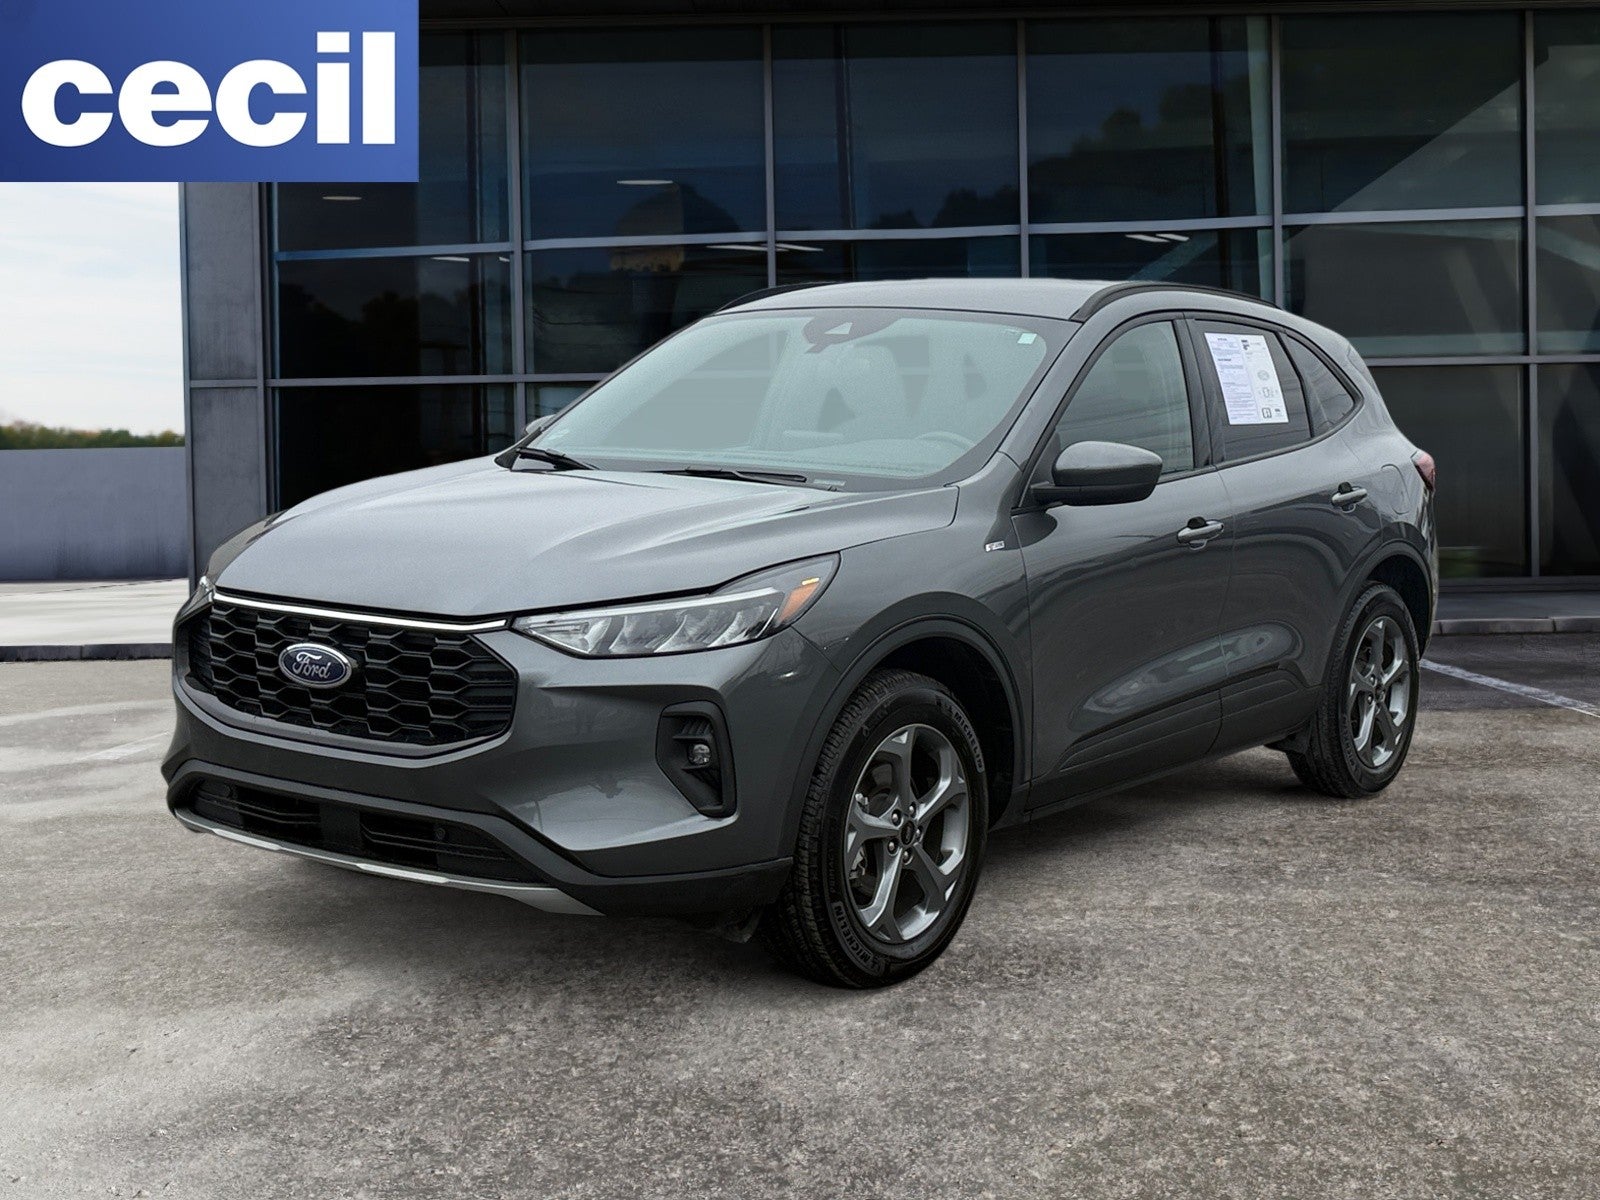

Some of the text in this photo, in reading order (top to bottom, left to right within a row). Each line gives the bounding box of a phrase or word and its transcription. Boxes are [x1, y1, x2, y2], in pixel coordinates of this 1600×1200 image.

[291, 651, 332, 679] Ford
[953, 711, 983, 769] MICHELIN
[834, 904, 872, 963] MICHELIN
